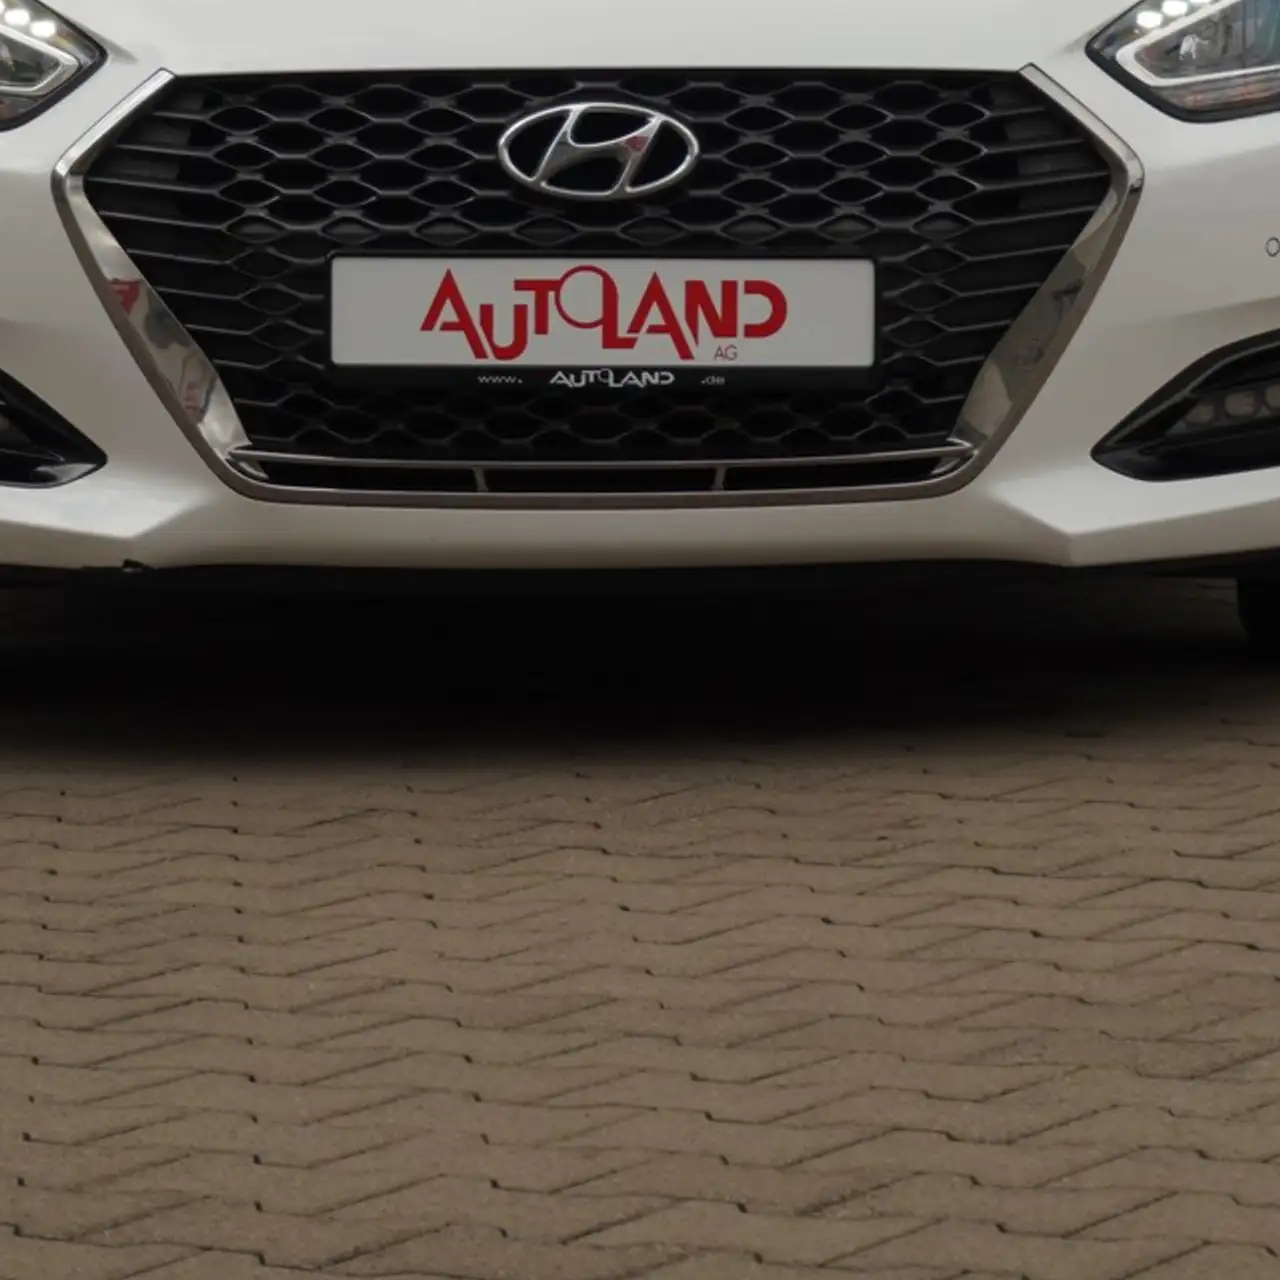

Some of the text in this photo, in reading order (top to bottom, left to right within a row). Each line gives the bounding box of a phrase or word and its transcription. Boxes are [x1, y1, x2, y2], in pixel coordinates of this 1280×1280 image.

[419, 264, 788, 361] AUTOLAND
[713, 345, 738, 361] AG
[477, 368, 725, 387] www. AUTOLAND .de
